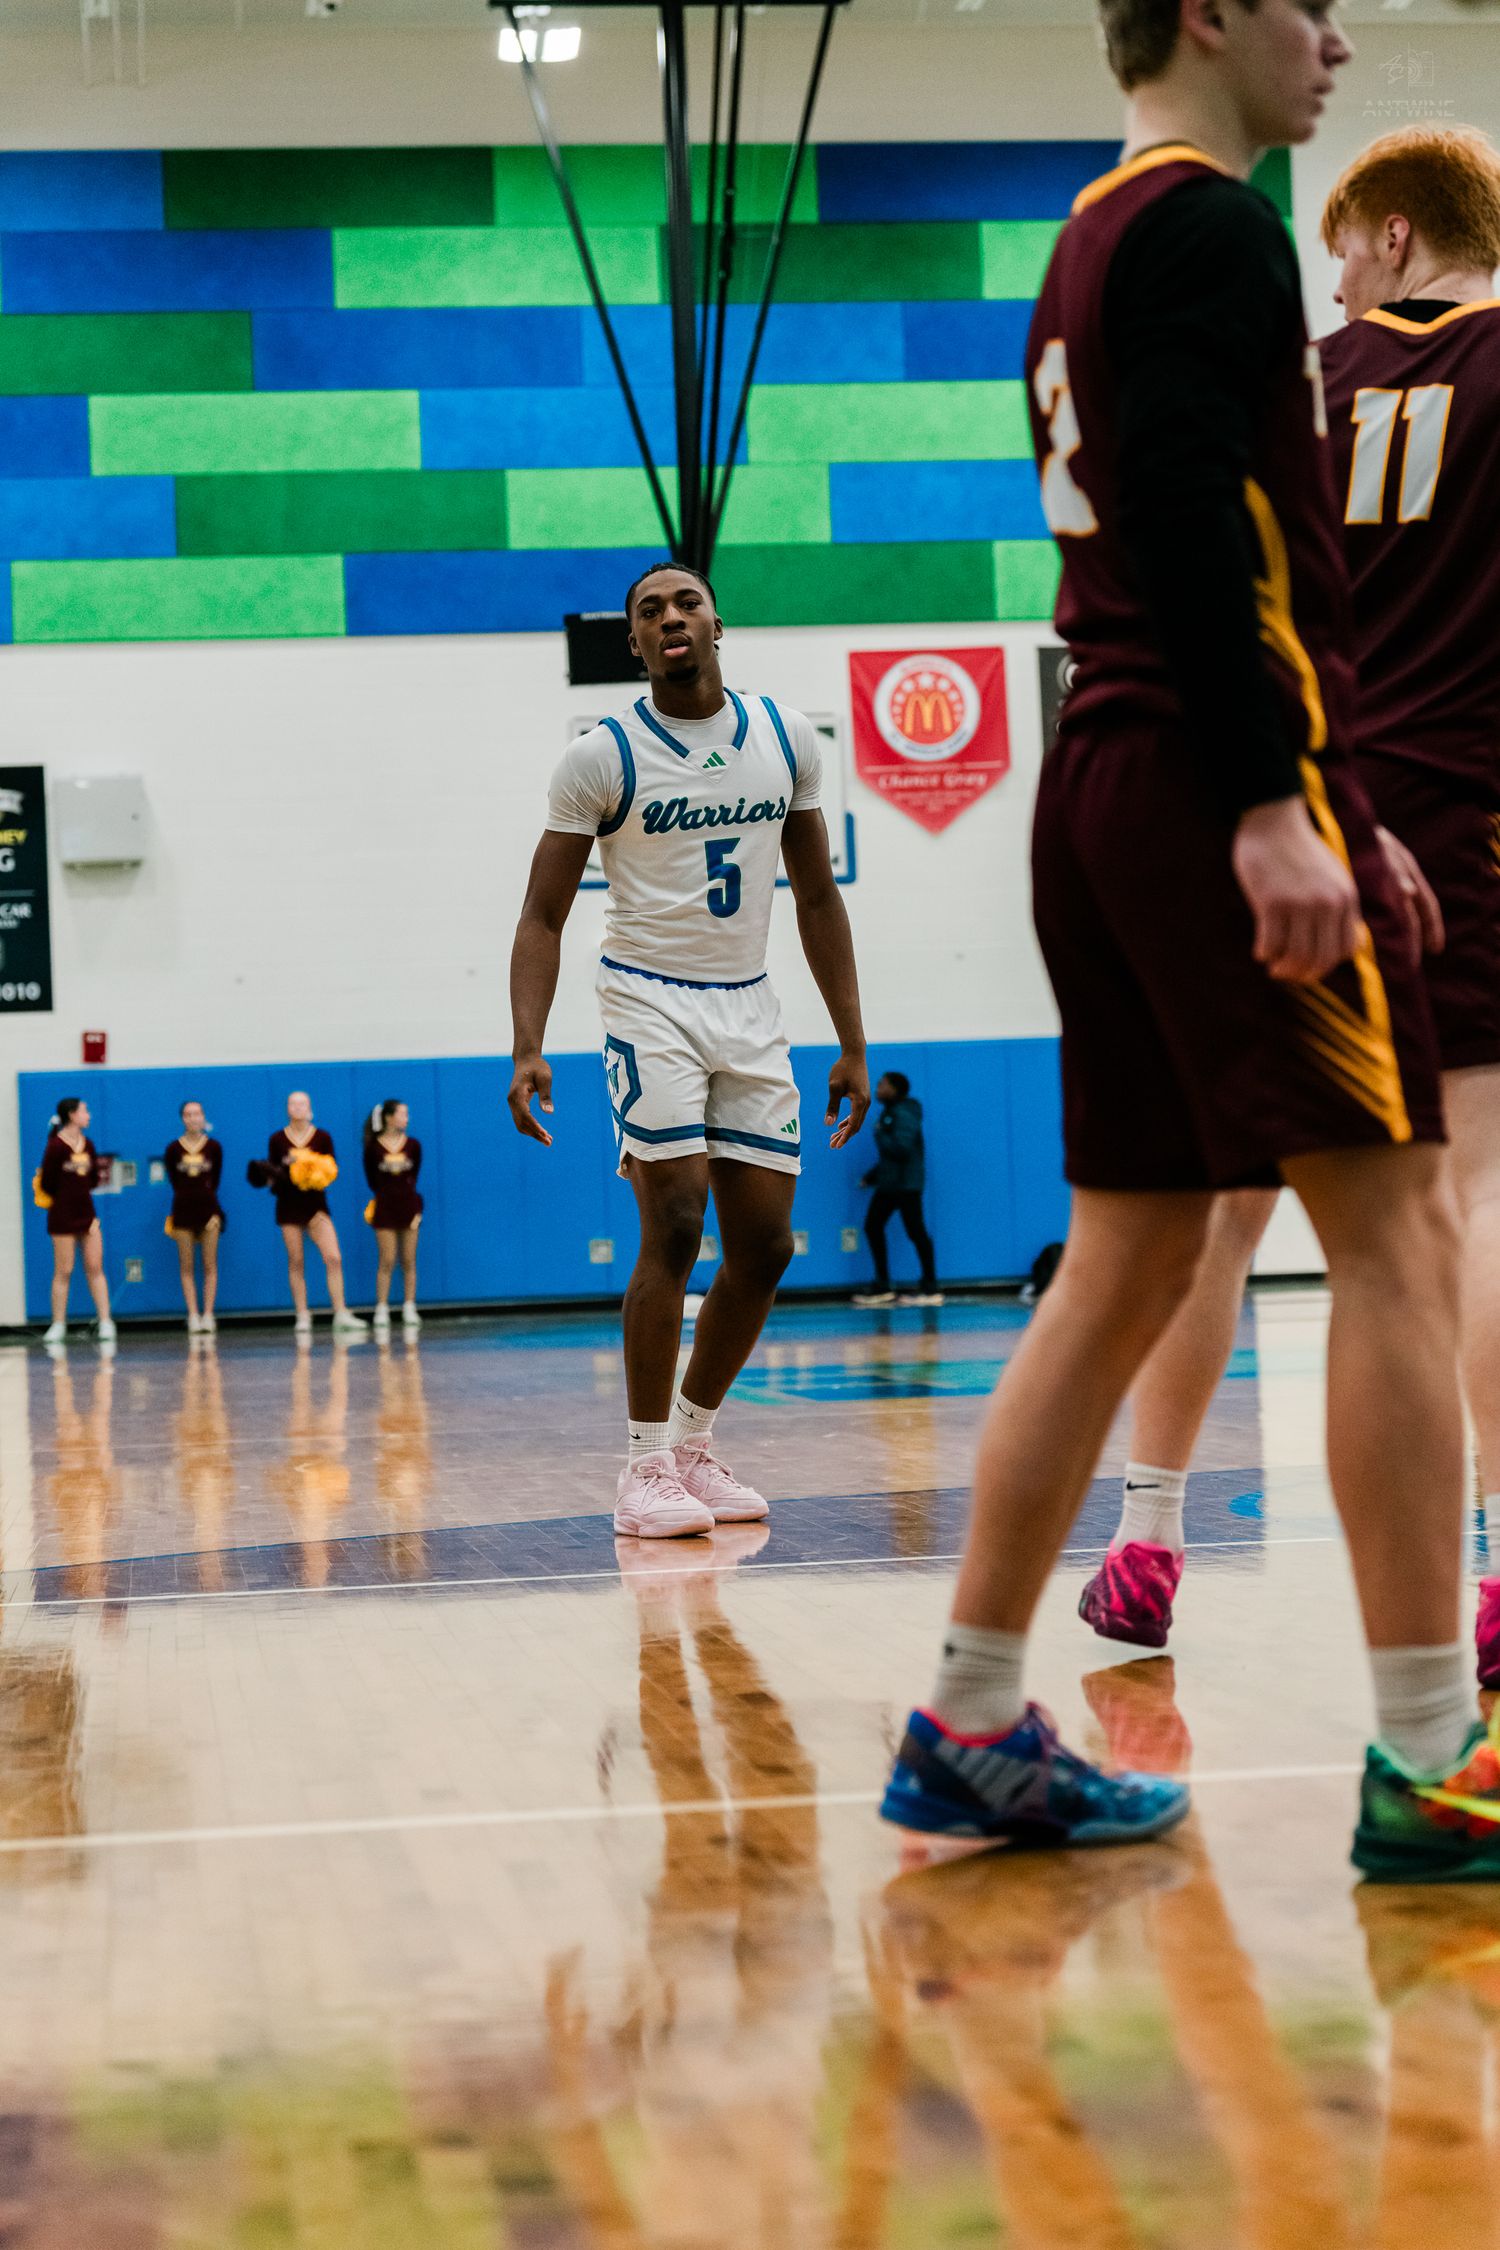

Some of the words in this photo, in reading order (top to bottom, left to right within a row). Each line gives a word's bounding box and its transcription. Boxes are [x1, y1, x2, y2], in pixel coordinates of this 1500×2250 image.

[1345, 383, 1454, 524] 11
[642, 796, 786, 835] Warriors
[704, 837, 742, 919] 5
[0, 982, 41, 1001] 010
